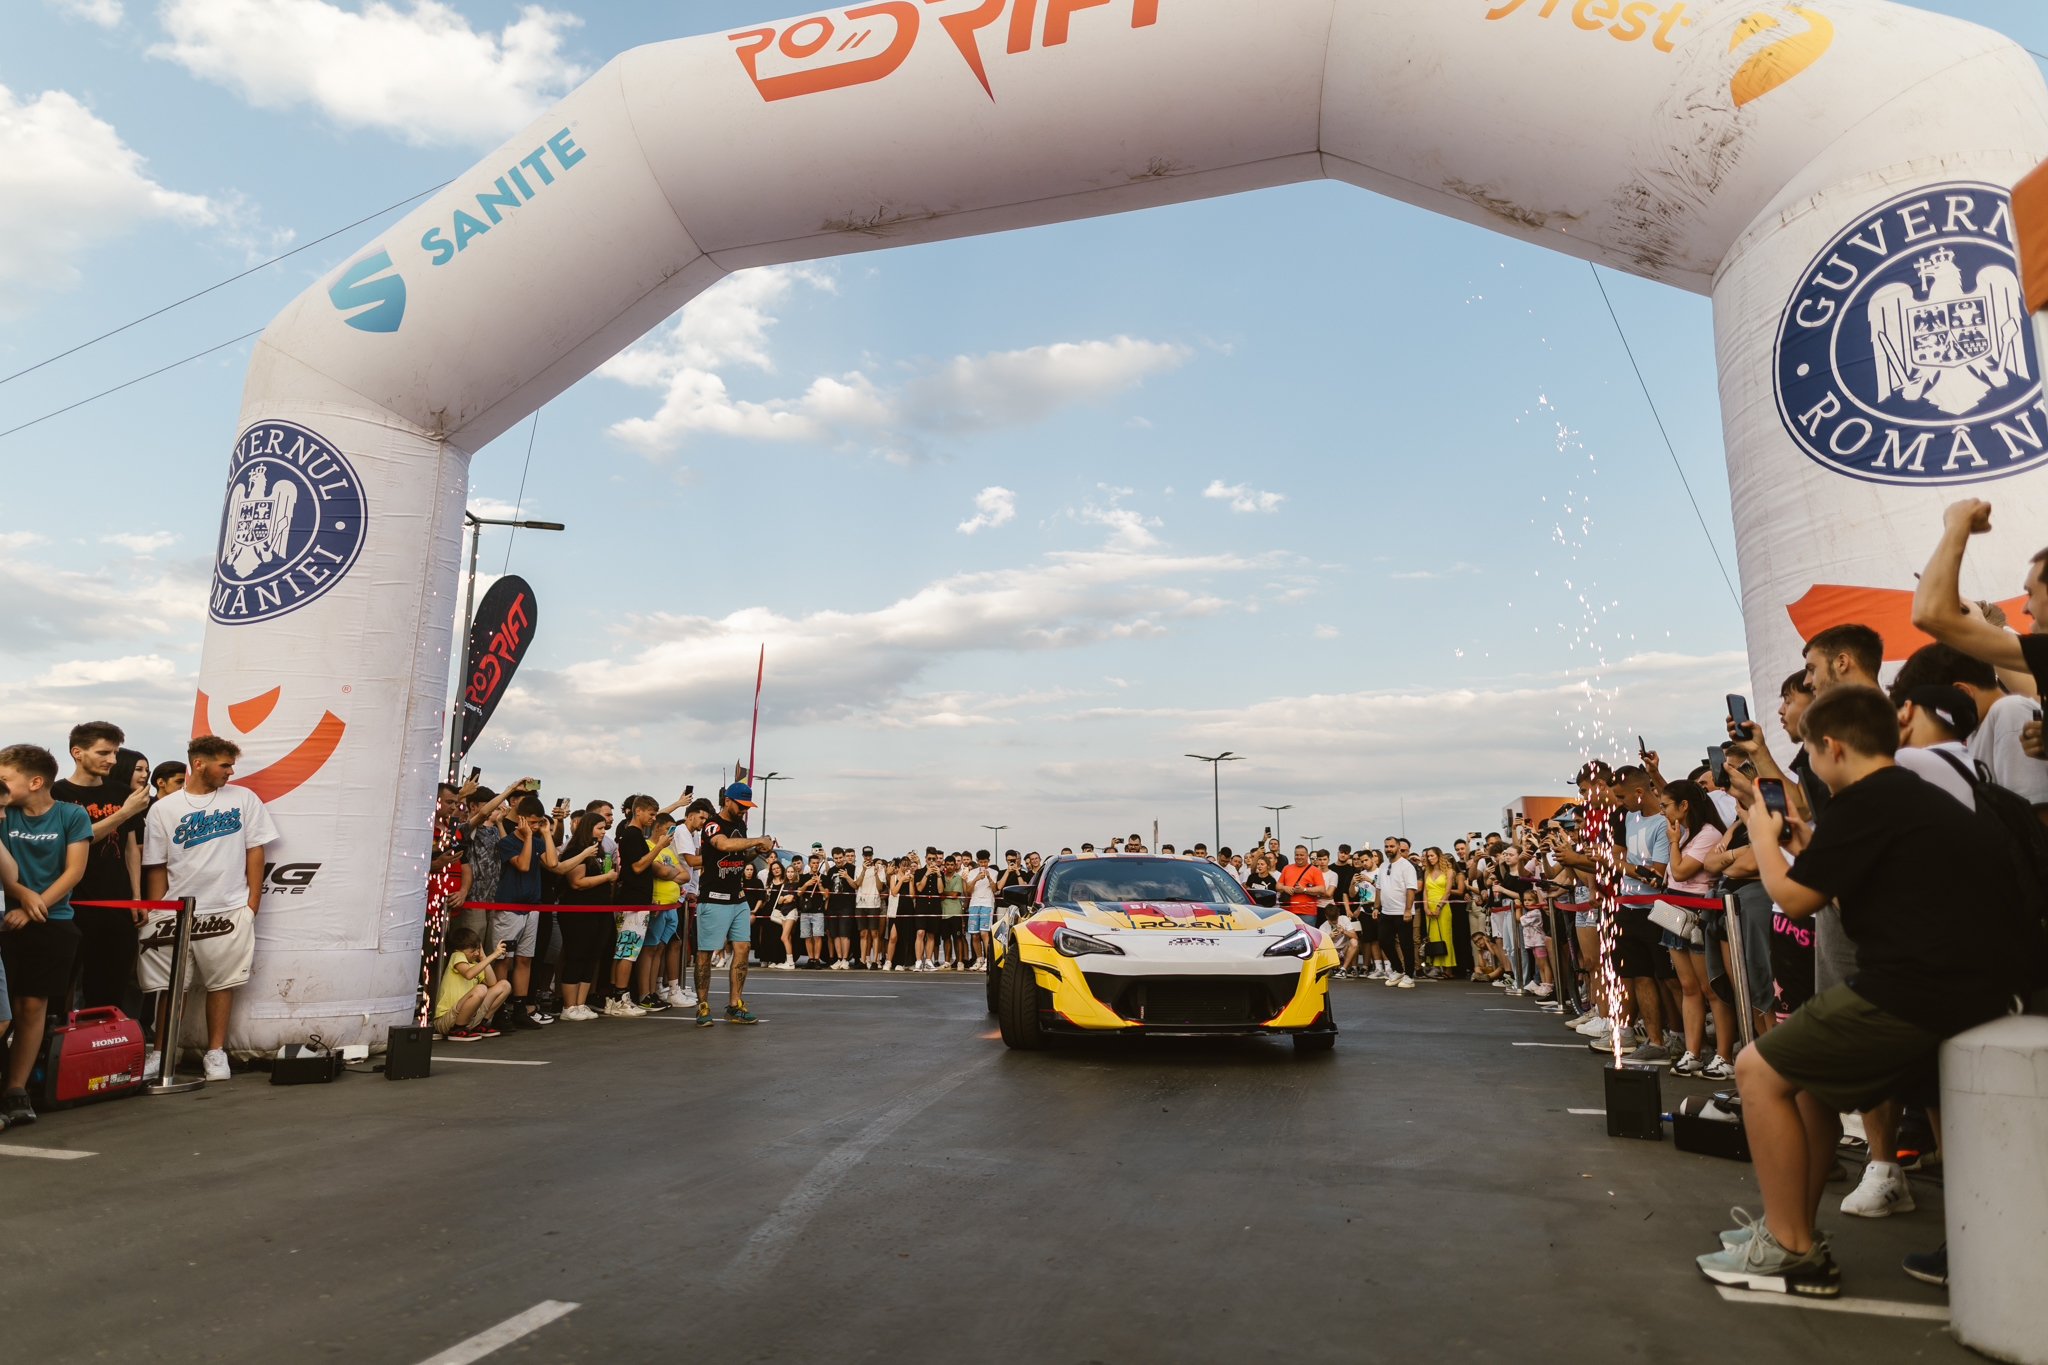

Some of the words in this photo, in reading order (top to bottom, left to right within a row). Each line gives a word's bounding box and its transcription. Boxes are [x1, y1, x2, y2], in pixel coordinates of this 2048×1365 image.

[421, 127, 587, 266] SANITE
[227, 429, 349, 501] UVERNUL
[1797, 391, 2048, 472] ROMÂN
[211, 544, 344, 615] OMÂNIEI
[1140, 921, 1225, 929] ROEN
[92, 1036, 129, 1048] HONDA
